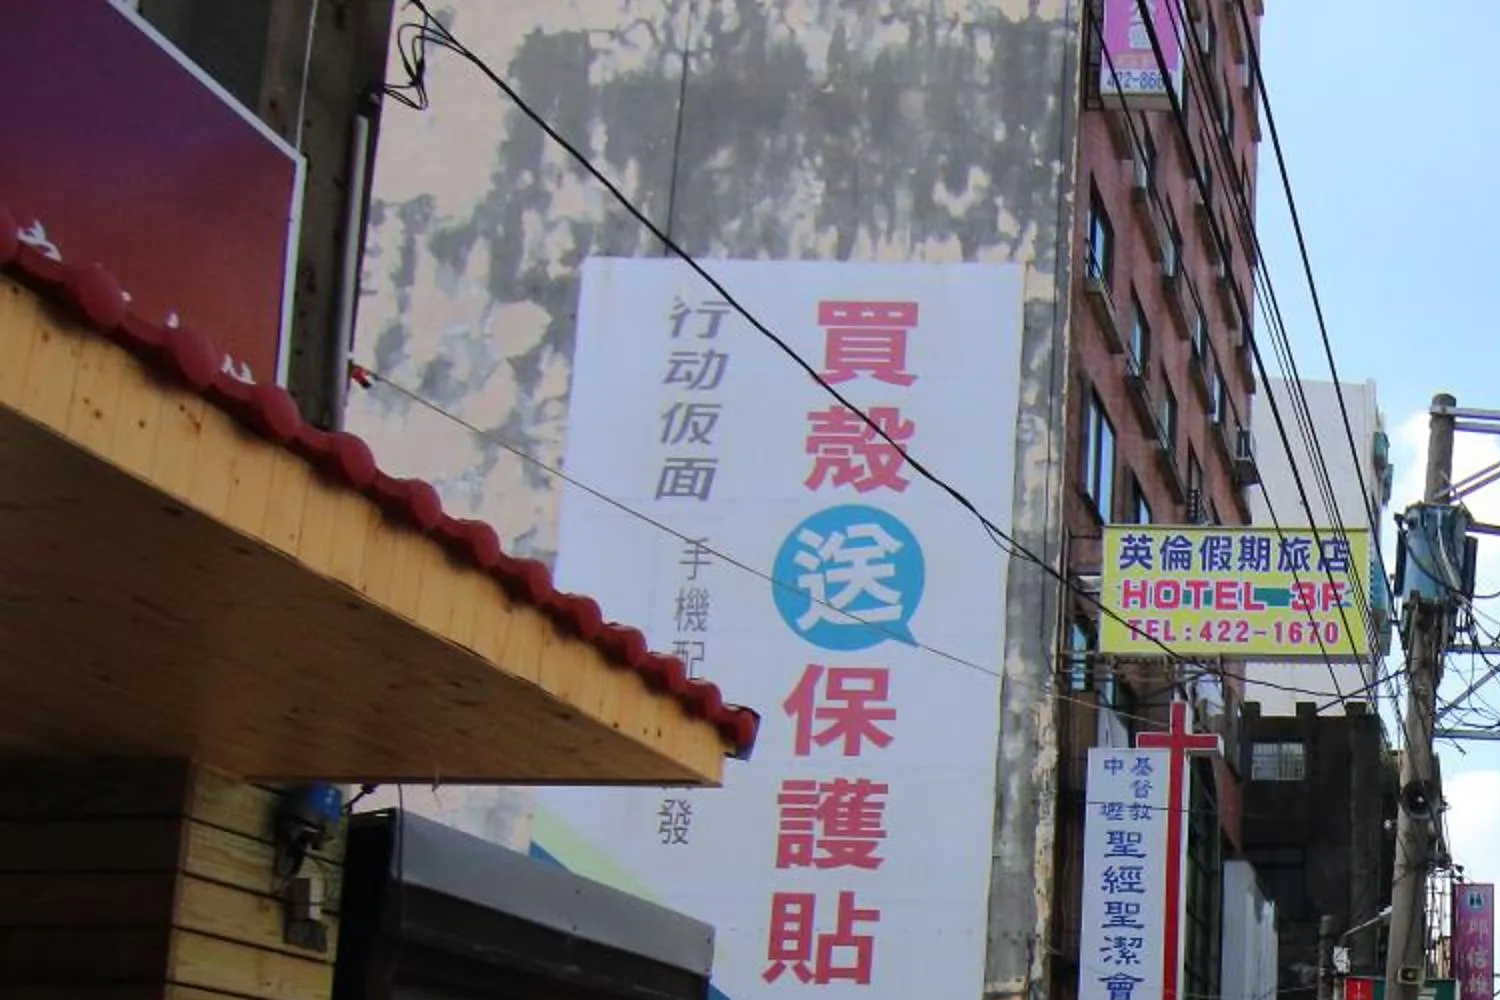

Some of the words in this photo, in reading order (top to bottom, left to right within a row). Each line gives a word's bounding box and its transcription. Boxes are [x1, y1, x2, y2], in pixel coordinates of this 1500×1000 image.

[1119, 533, 1350, 574] 英倫假期旅店
[1121, 578, 1266, 612] HOTEL
[1290, 581, 1347, 612] 3F
[761, 300, 919, 986] 買殼送保護貼
[1128, 756, 1154, 821] 基督教
